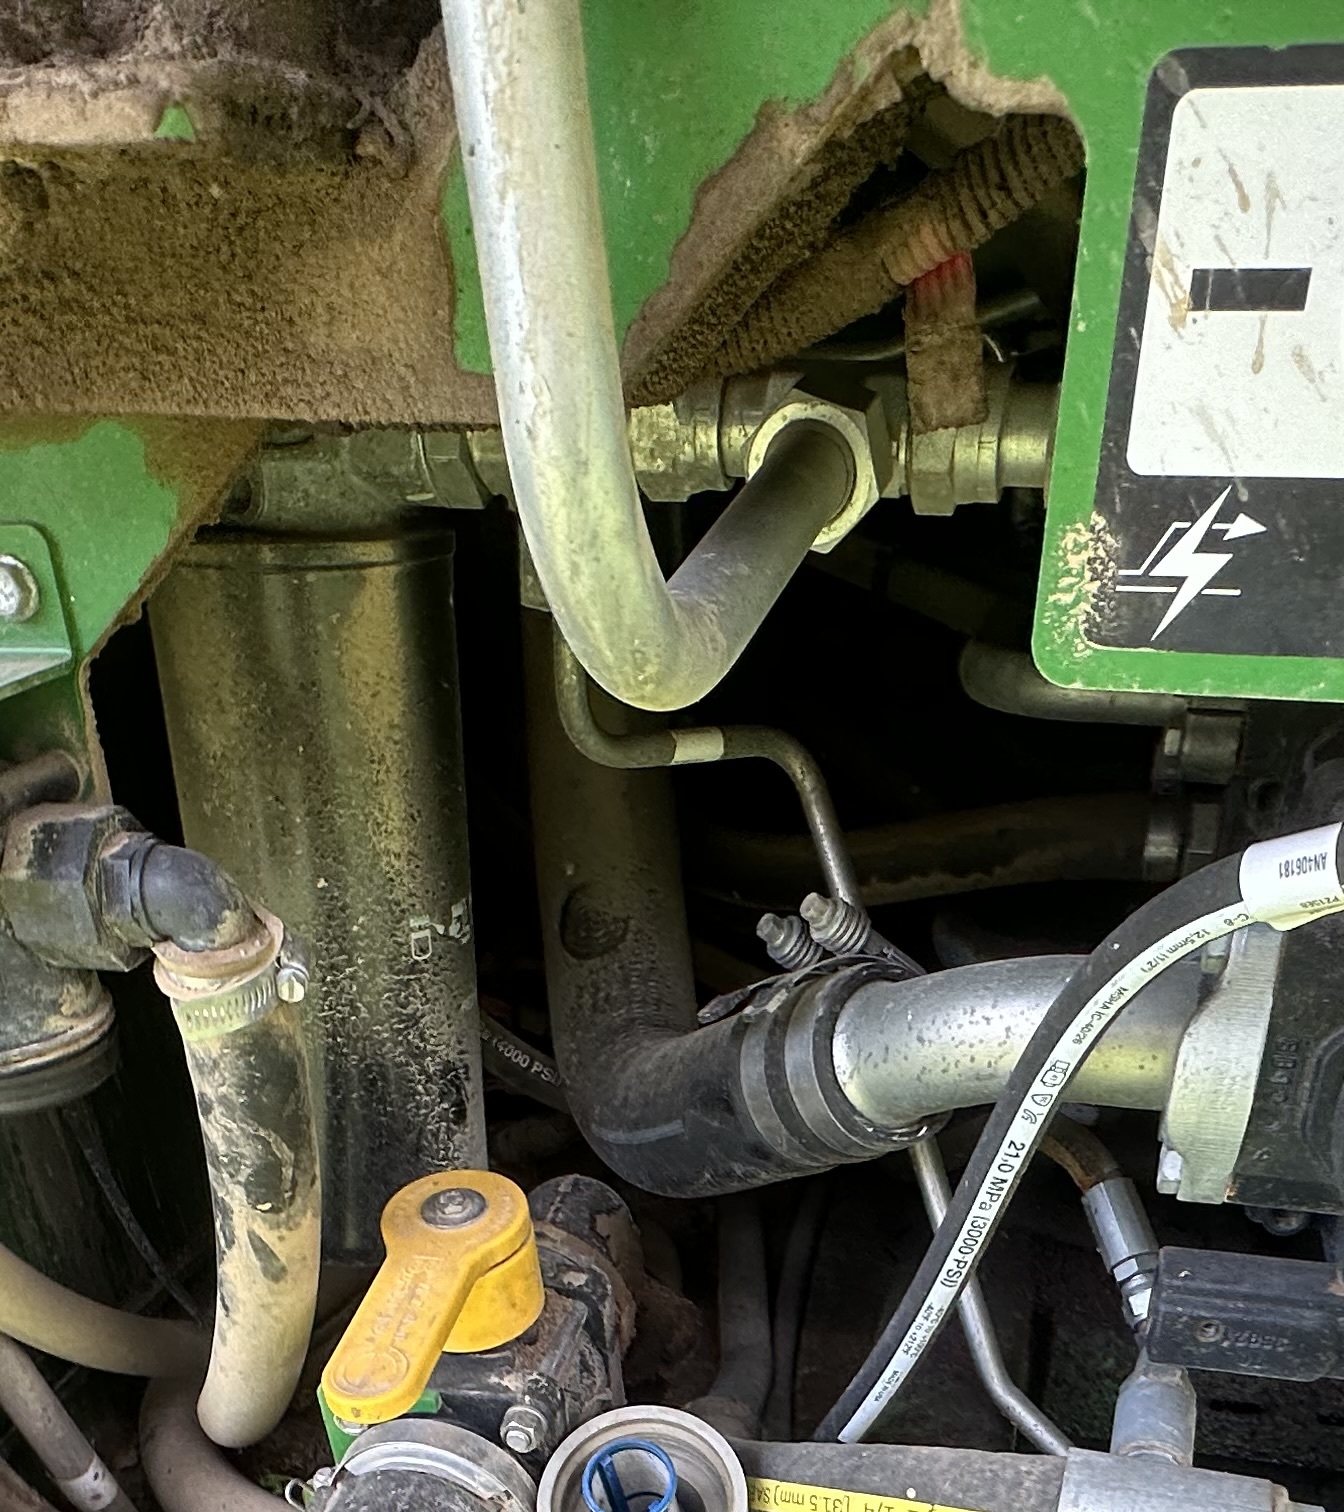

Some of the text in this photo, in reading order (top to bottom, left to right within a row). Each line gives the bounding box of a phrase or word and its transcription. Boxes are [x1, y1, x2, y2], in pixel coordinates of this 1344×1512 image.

[1278, 852, 1328, 879] AN406181
[940, 1139, 1027, 1289] 21,0 MPa (3000 PSI)
[773, 1484, 806, 1507] mm)
